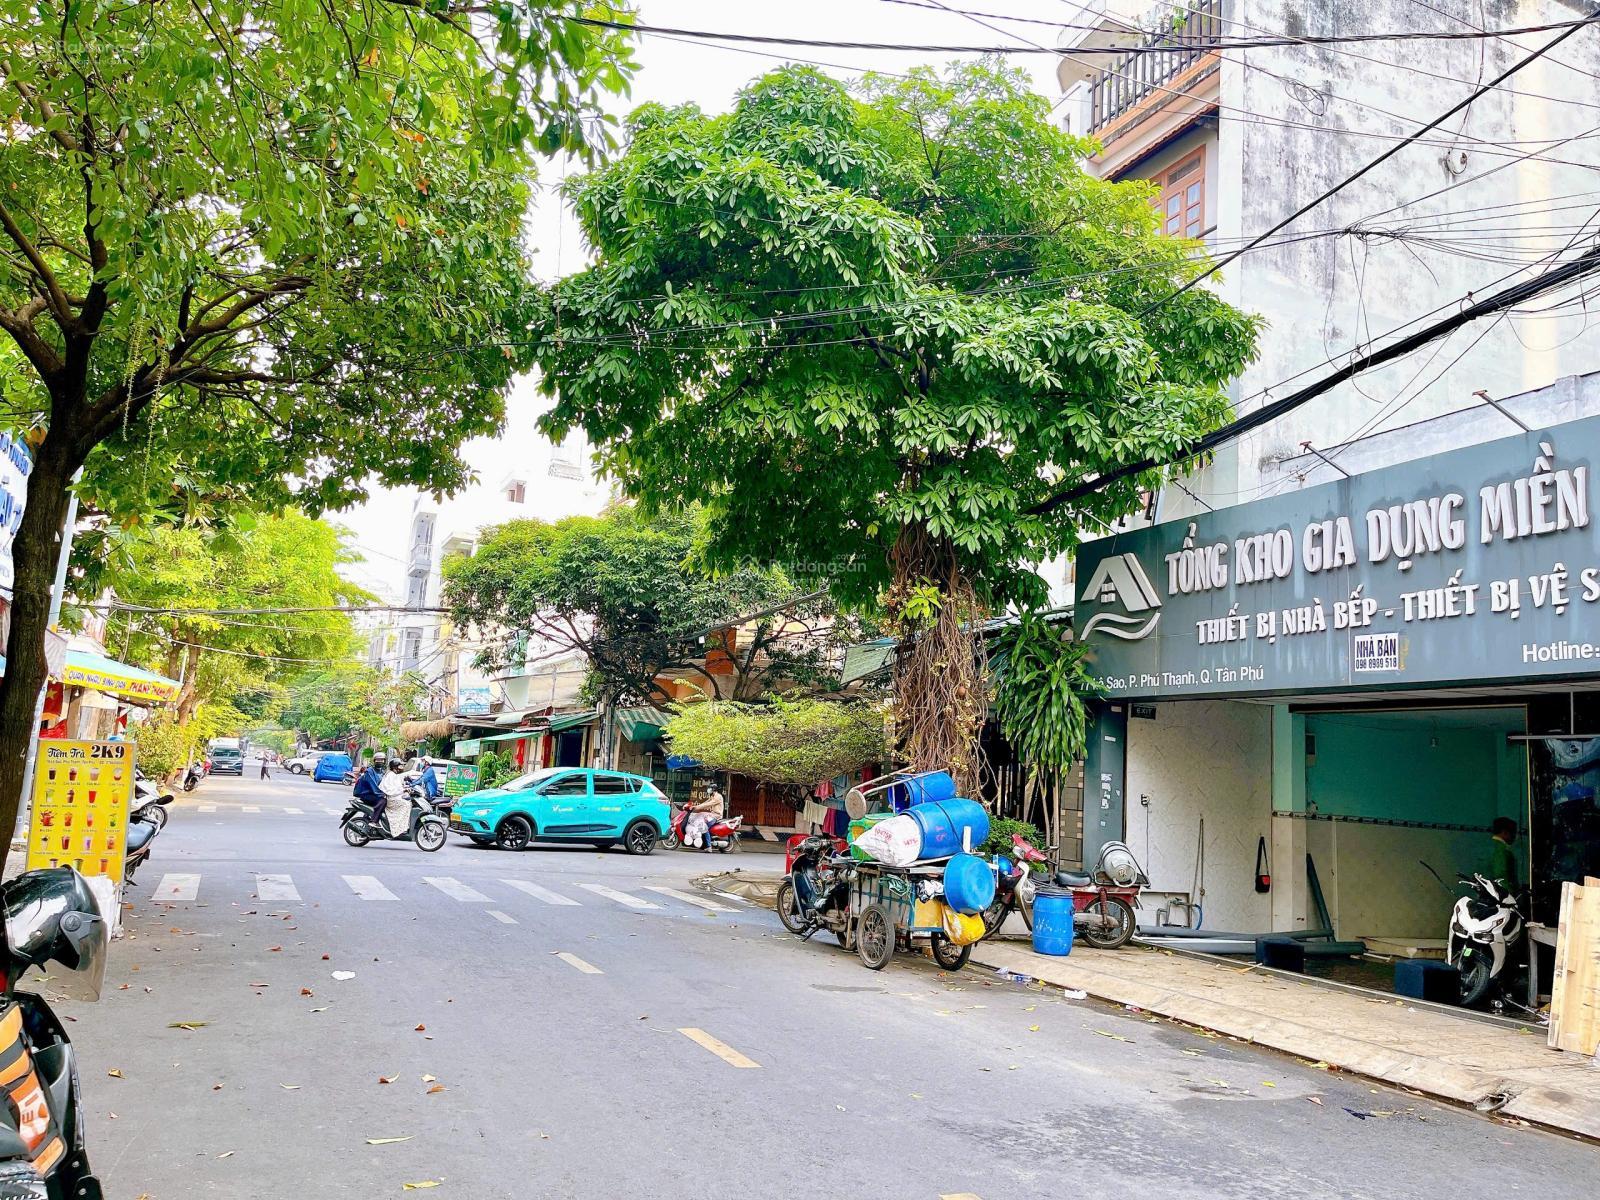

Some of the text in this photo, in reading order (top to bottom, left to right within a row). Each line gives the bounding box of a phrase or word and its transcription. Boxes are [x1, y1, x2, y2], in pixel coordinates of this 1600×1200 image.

[1164, 441, 1590, 595] TỔNG KHO GIA DỤNG MIỀN
[1196, 602, 1250, 645] THIẾT
[1256, 610, 1276, 645] BỊ
[1282, 597, 1327, 635] NHÀ
[1333, 583, 1379, 630] BẾP
[1399, 568, 1480, 622] THIẾT
[1489, 578, 1521, 619] BỊ
[1528, 562, 1570, 615] VỆ
[1356, 635, 1396, 658] NHÀ BÁN
[1522, 640, 1600, 663] Hotline:
[1106, 676, 1127, 691] Sao,
[1129, 674, 1138, 688] P.
[1140, 671, 1160, 688] Phú
[1162, 670, 1199, 689] Thạnh,
[1200, 669, 1213, 684] Q.
[1215, 667, 1237, 683] Tân
[1240, 664, 1265, 682] Phú
[47, 744, 125, 760] Tiệm Trà 2K9
